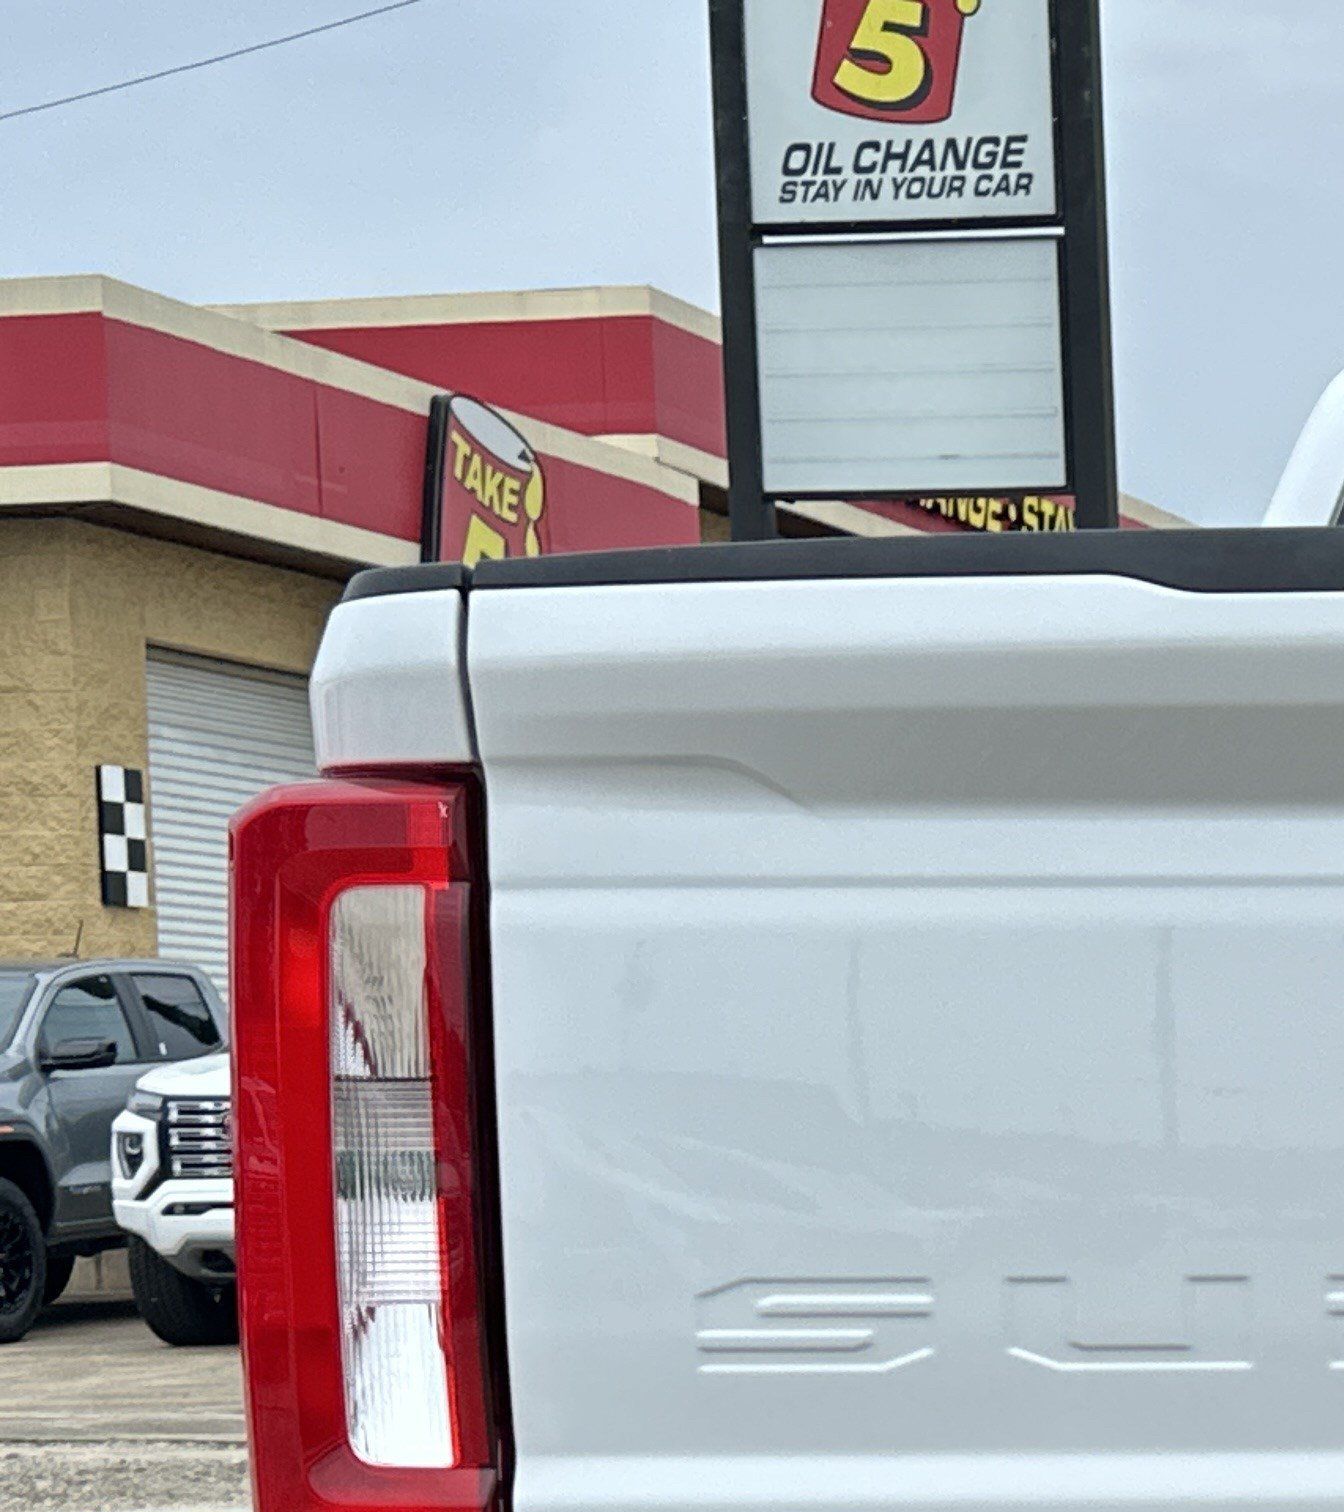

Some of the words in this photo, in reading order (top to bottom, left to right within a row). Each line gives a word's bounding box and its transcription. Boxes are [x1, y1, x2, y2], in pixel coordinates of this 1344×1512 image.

[832, 0, 928, 106] 5
[778, 178, 847, 204] STAY
[852, 178, 882, 201] IN
[891, 174, 966, 200] YOUR
[973, 173, 1033, 197] CAR
[781, 142, 844, 177] OIL
[852, 134, 1028, 174] CHANGE
[451, 430, 521, 524] TAKE
